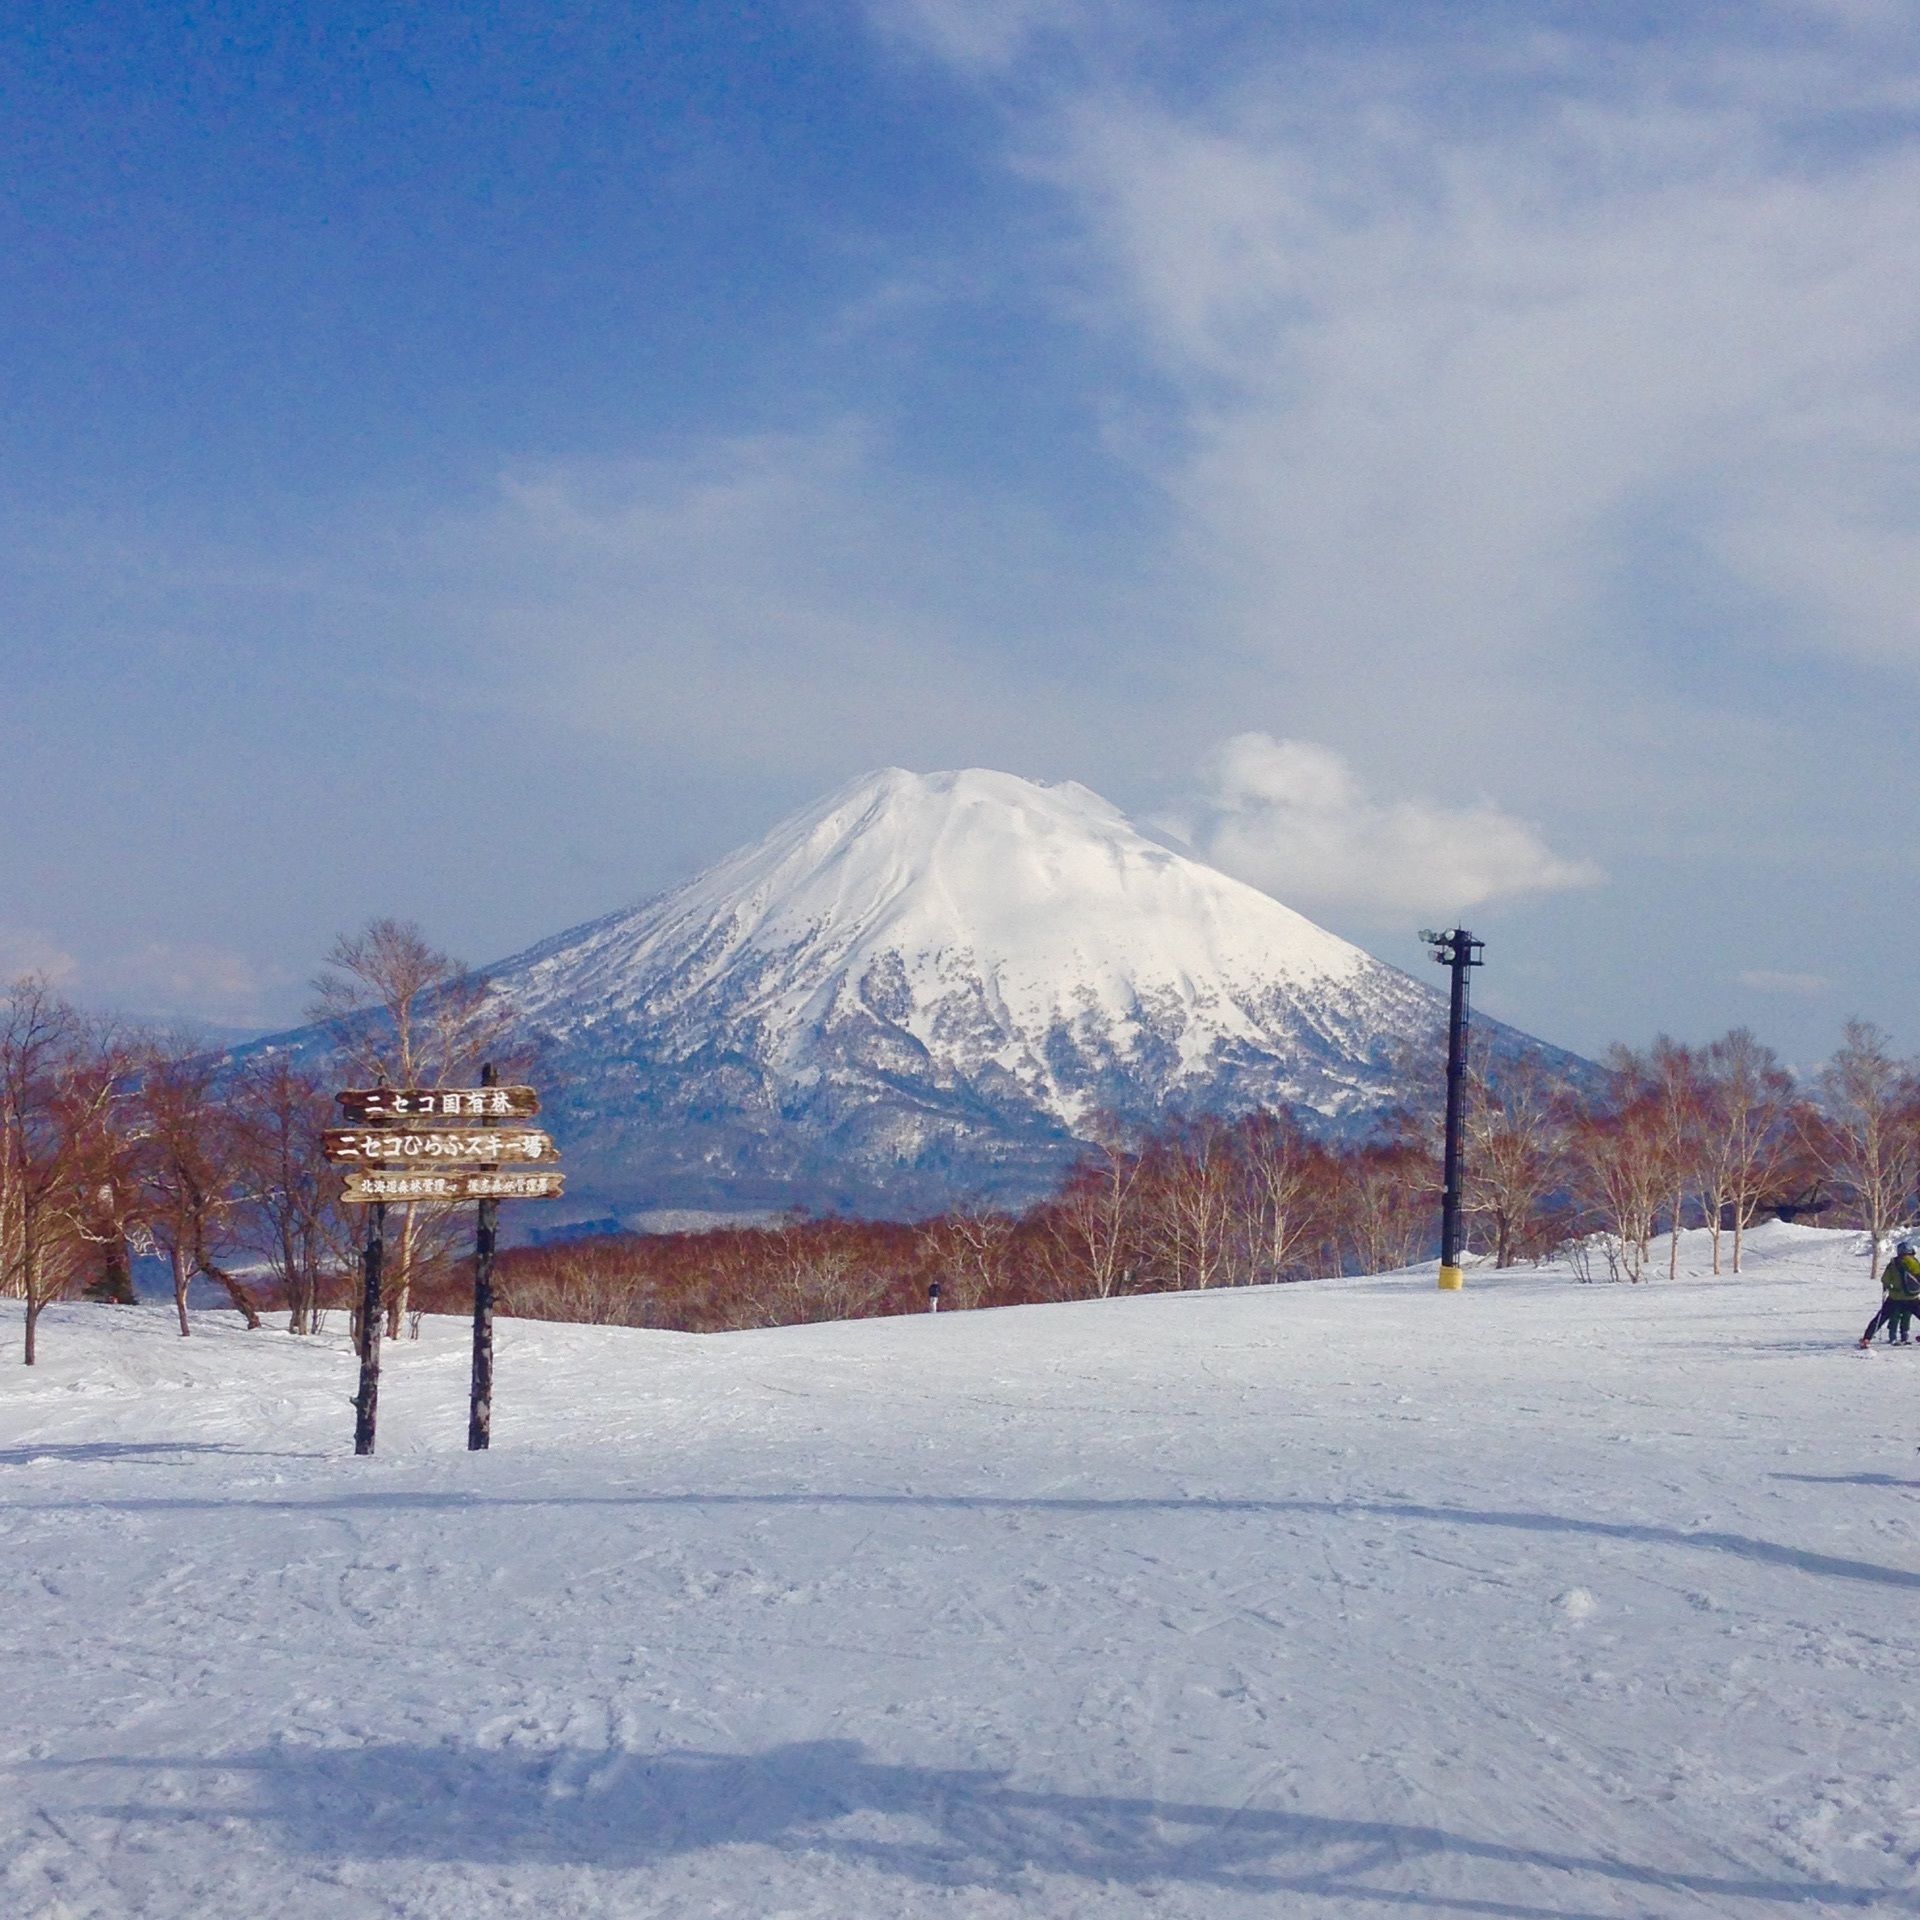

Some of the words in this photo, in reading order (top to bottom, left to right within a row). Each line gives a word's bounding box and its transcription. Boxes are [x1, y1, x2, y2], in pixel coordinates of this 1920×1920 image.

[364, 1092, 512, 1114] ニセコ国有林
[337, 1134, 543, 1159] ニセコひらふスキー場
